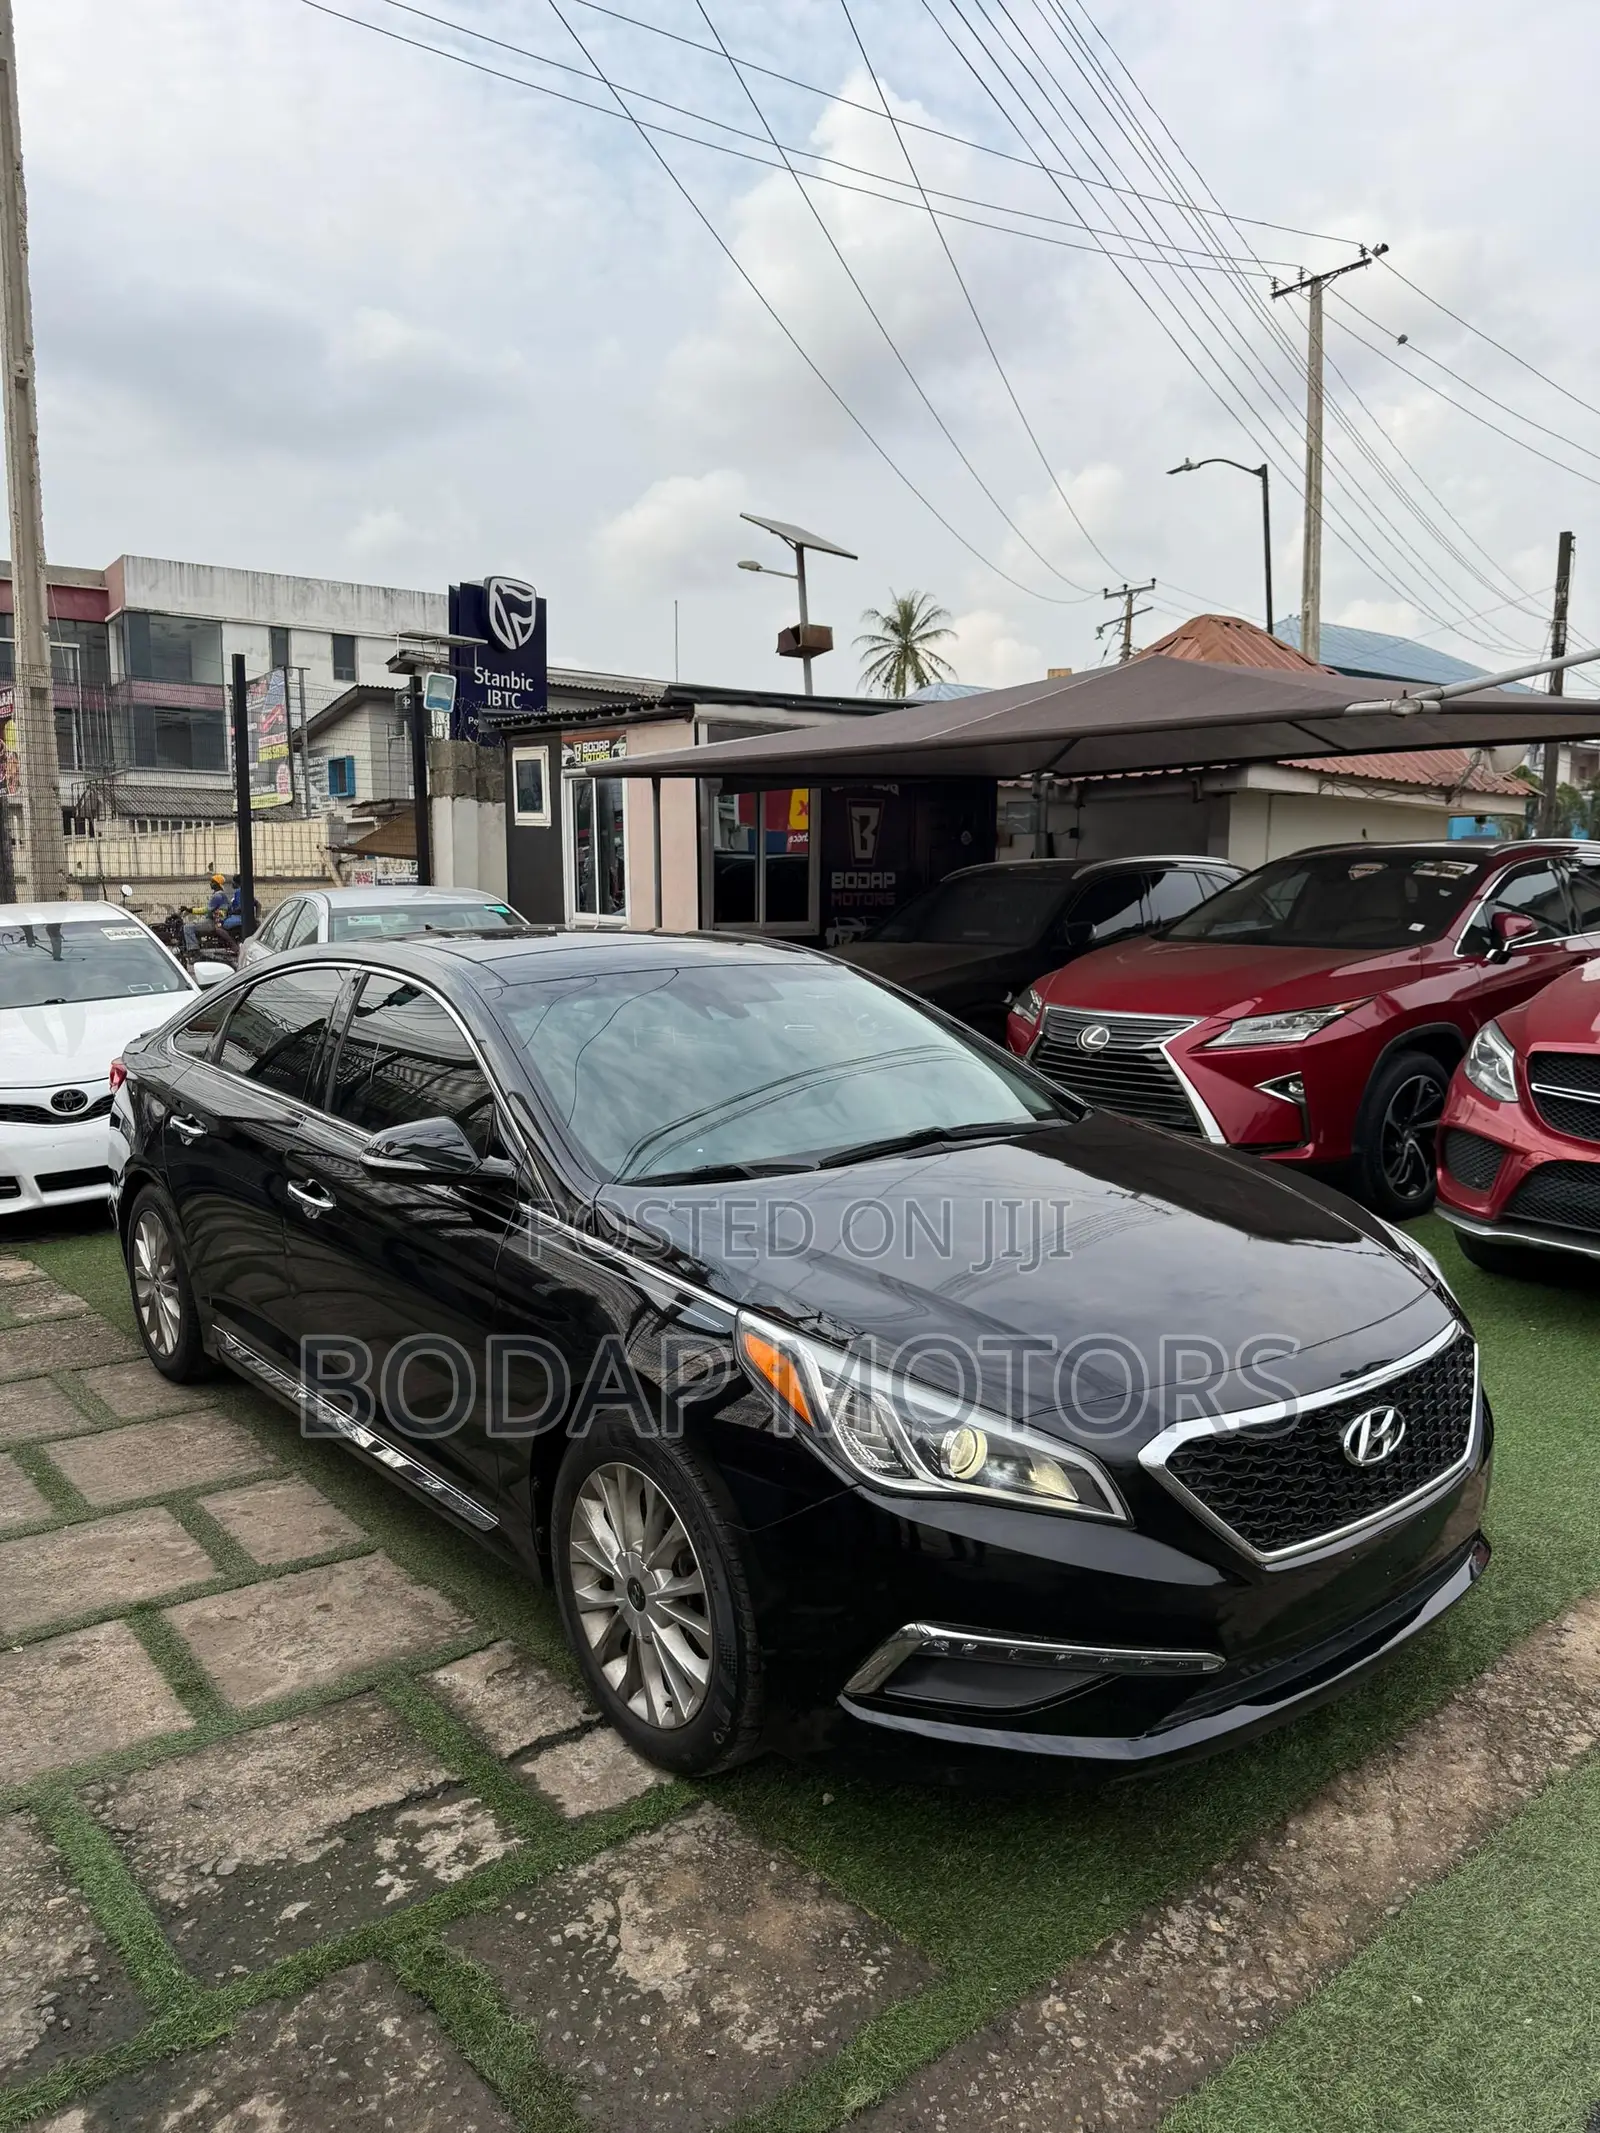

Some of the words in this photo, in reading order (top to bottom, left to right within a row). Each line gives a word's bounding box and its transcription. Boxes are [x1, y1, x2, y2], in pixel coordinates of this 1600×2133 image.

[474, 666, 534, 692] Stanbic
[487, 689, 522, 710] IBTC
[582, 740, 610, 753] BODAP
[582, 750, 611, 763] MOTORS
[831, 872, 896, 889] BODAP
[831, 892, 896, 906] MOTORS
